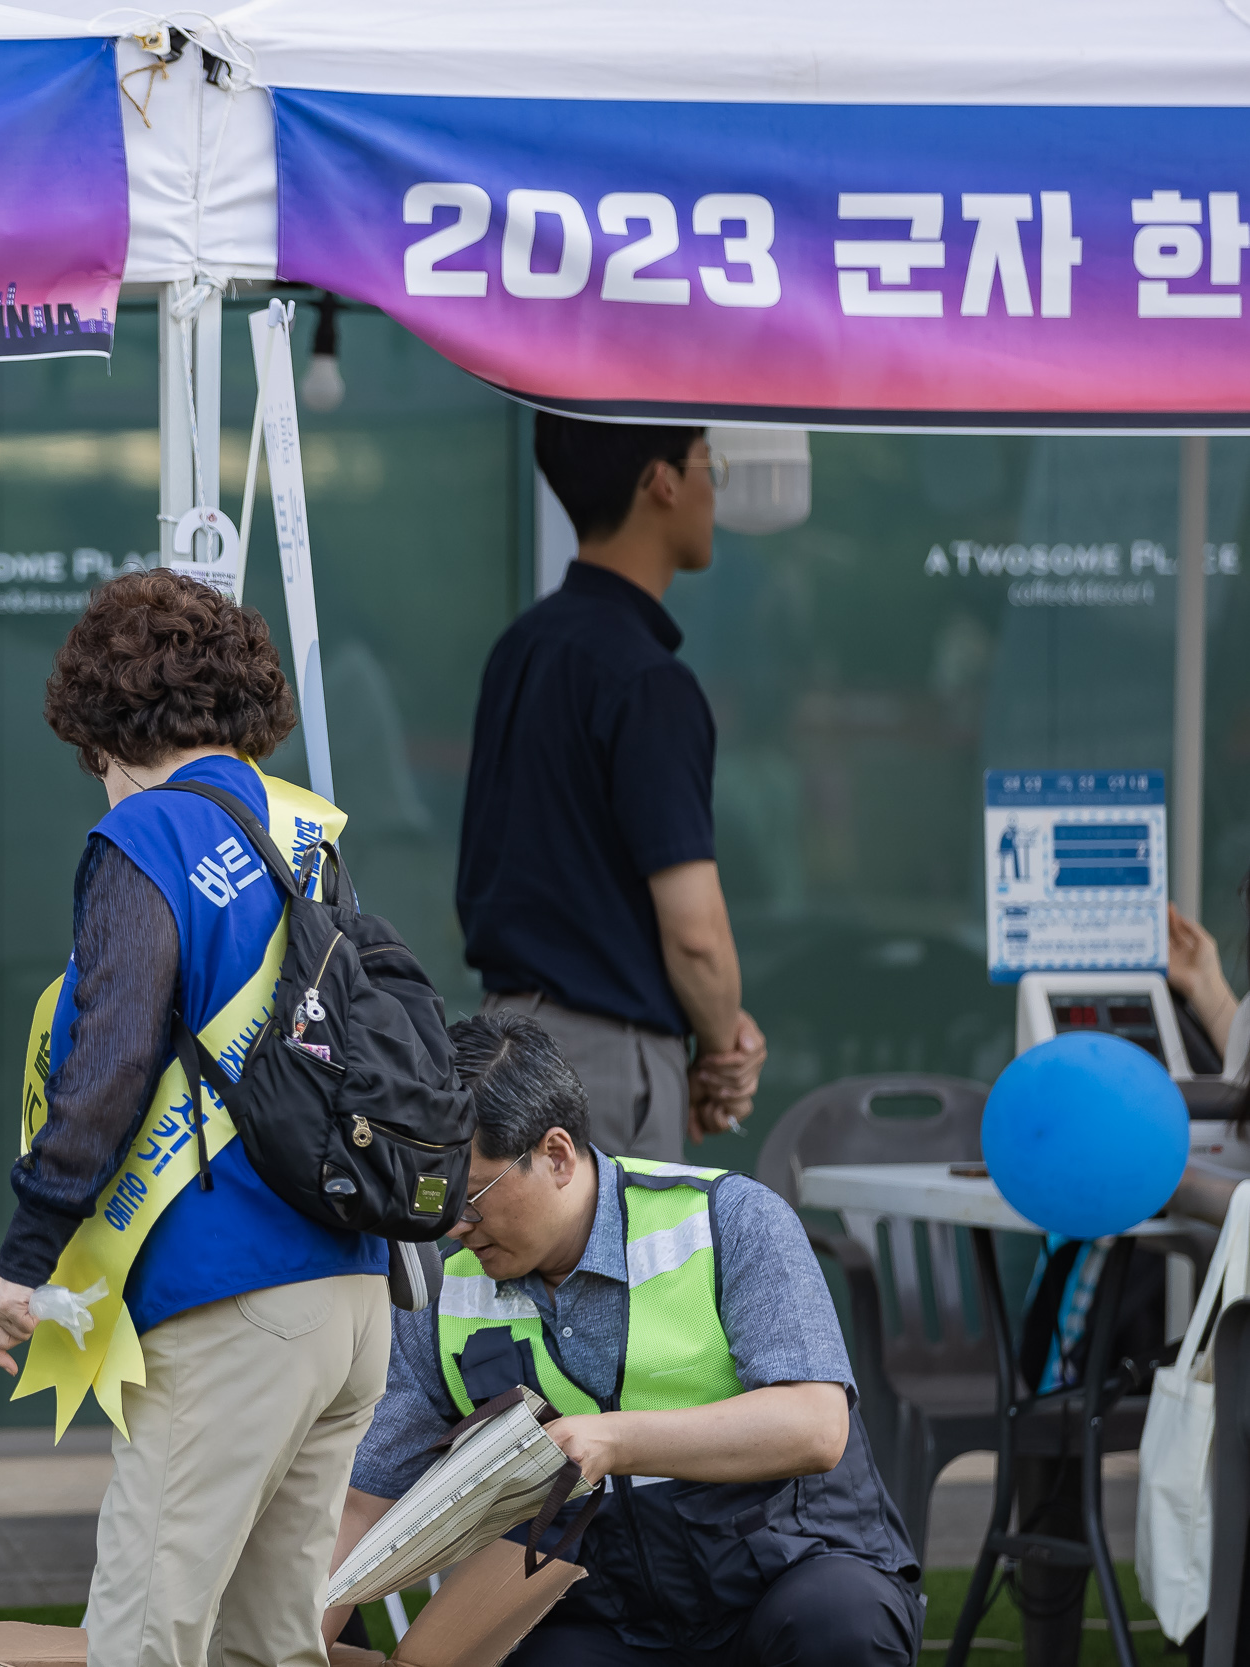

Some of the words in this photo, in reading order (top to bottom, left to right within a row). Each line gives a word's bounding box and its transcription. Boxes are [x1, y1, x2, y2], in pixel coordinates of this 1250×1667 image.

[402, 181, 782, 308] 2023
[834, 190, 1083, 319] 군자
[188, 836, 268, 908] 바르
[104, 1171, 148, 1232] 운동
